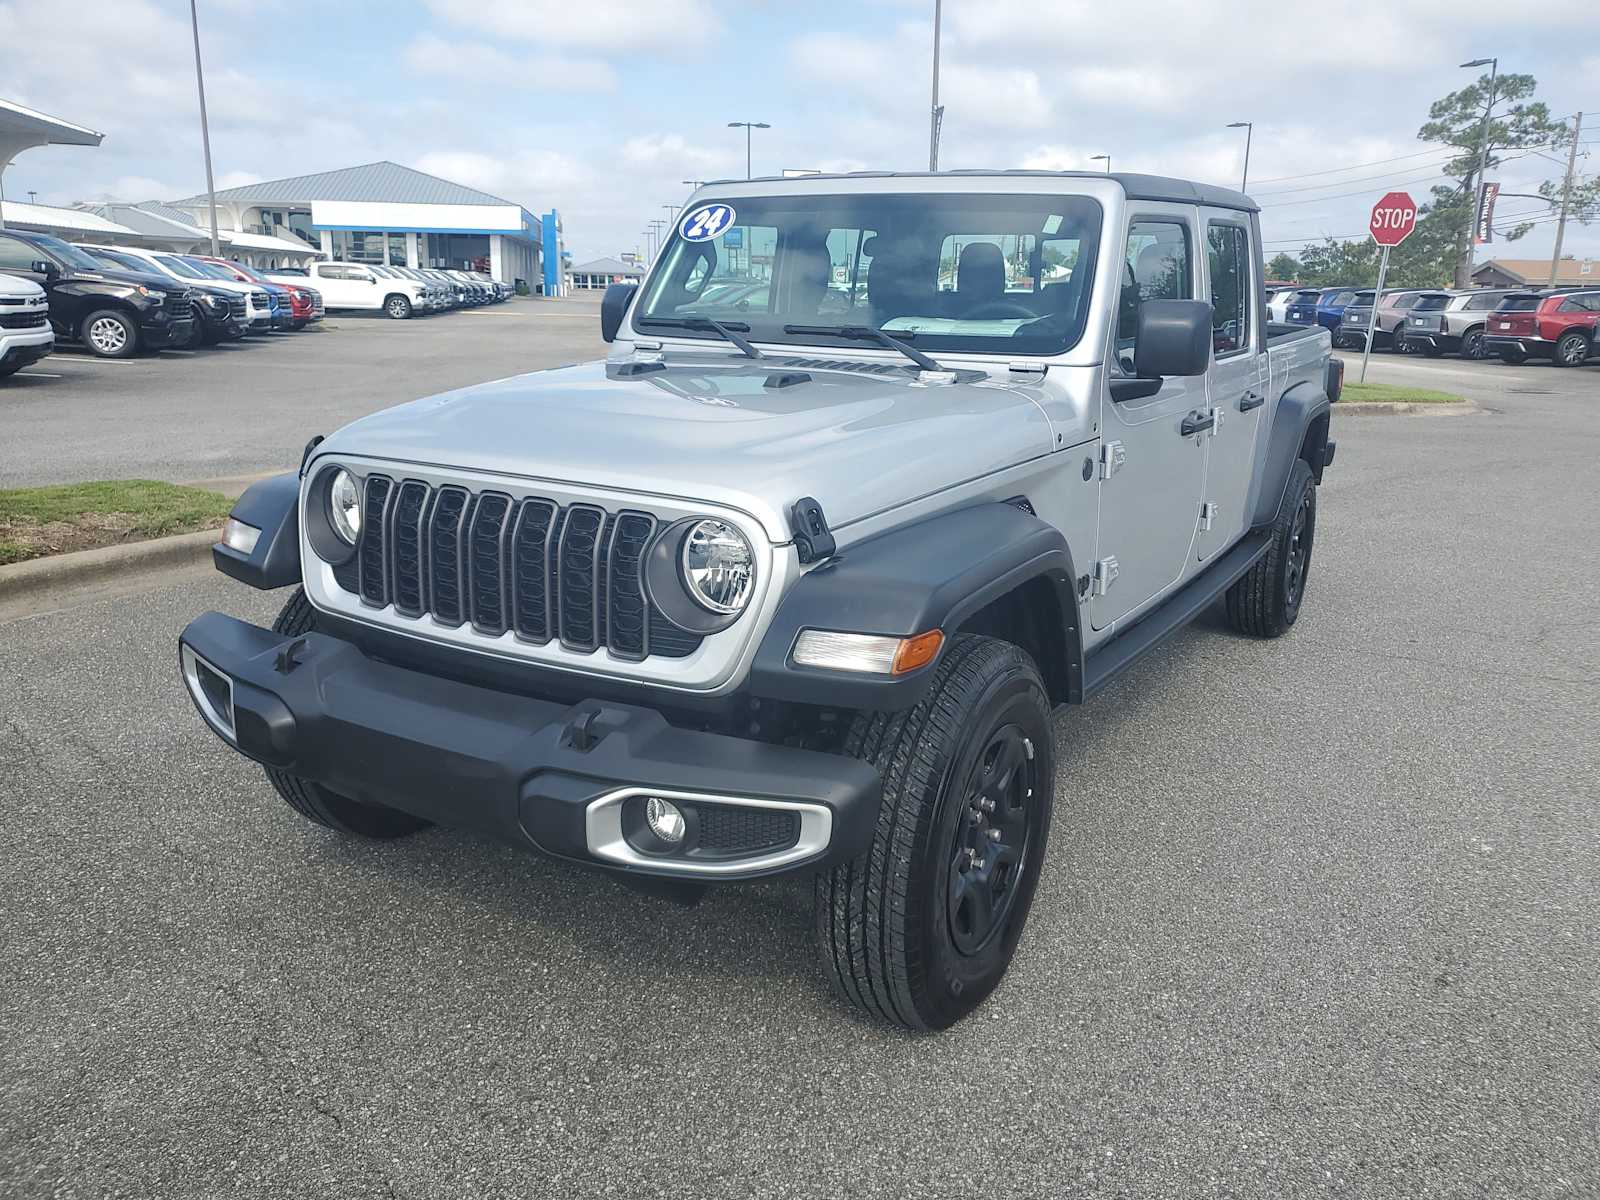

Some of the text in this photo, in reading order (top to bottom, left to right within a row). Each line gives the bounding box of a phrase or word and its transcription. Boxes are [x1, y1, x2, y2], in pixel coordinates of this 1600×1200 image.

[687, 207, 726, 237] 24
[1372, 208, 1413, 229] STOP
[1480, 221, 1488, 240] NEW
